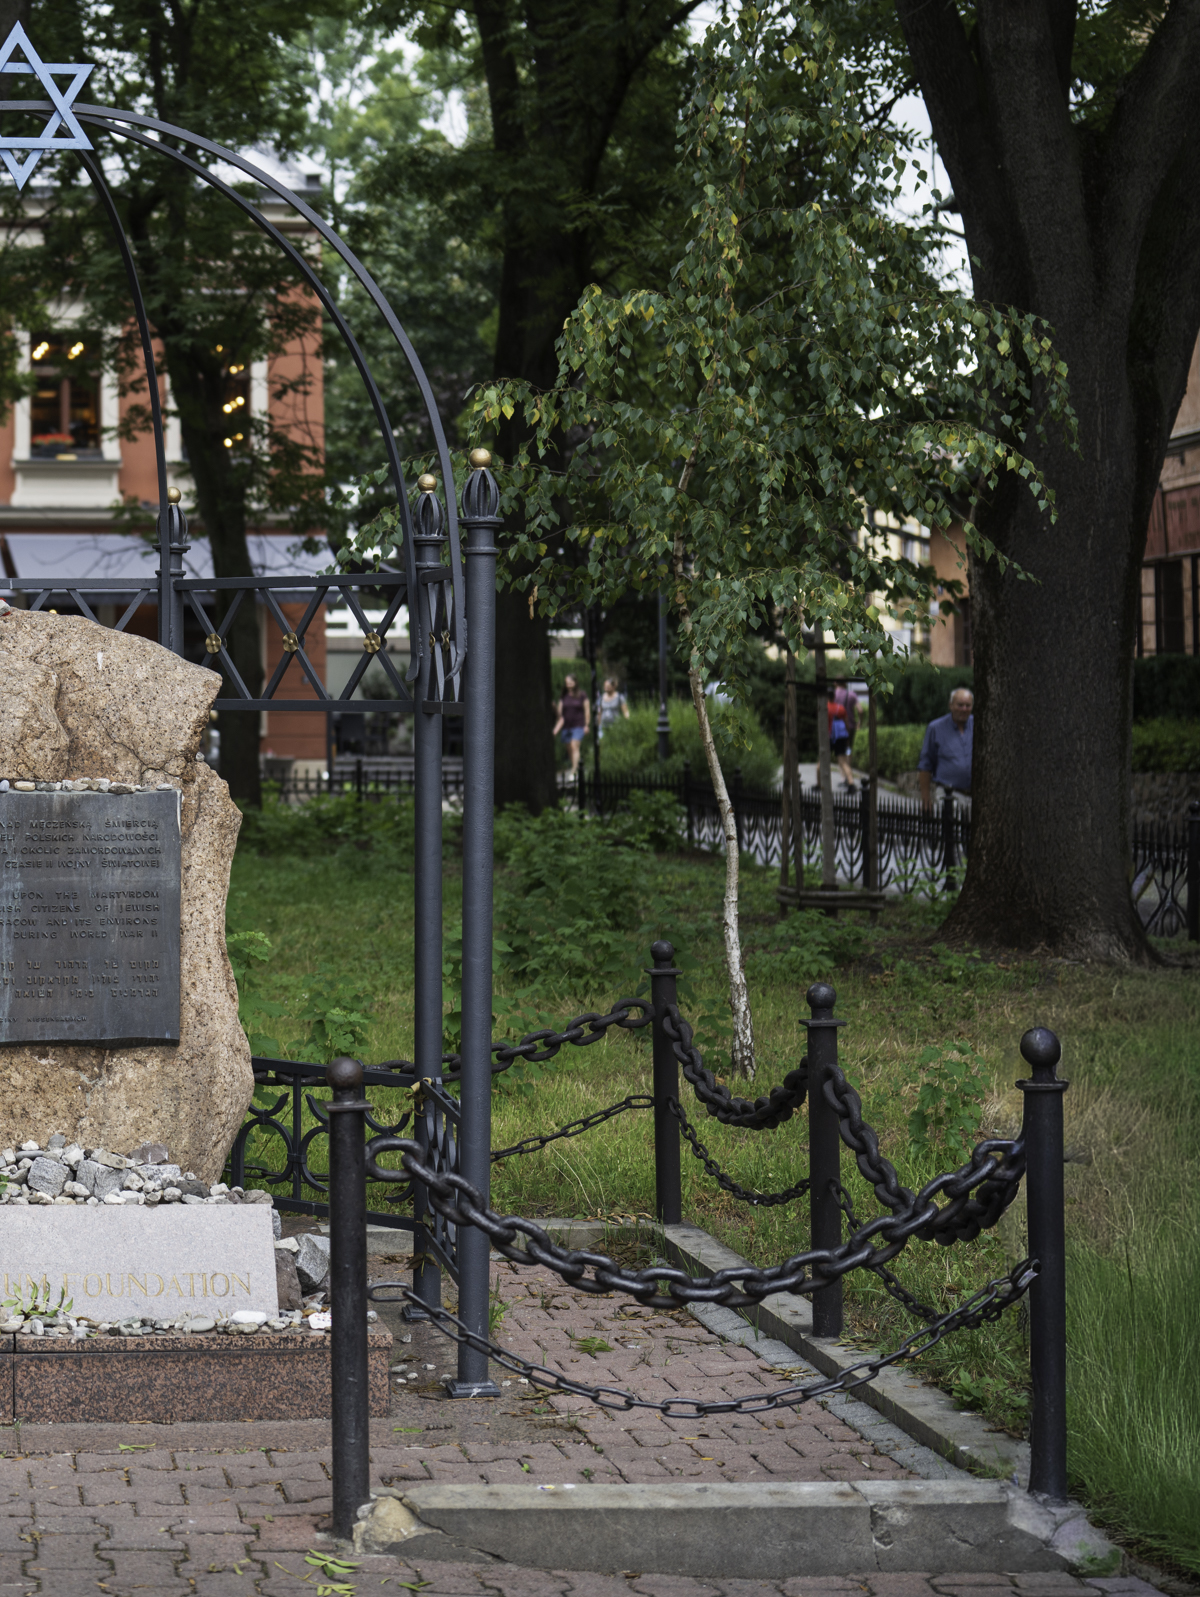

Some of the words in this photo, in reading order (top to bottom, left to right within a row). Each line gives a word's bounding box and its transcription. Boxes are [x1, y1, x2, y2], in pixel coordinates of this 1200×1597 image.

[25, 833, 74, 842] POLSKICH
[82, 831, 159, 842] NARODOWOŚCI
[20, 846, 60, 855] OKOLIC
[67, 846, 162, 855] ZAMORDOWANYCH
[4, 860, 42, 868] CZASIE
[58, 860, 92, 869] WOJNY
[12, 891, 43, 900] UPON
[55, 891, 78, 899] THE
[90, 890, 159, 899] MARTYRDOM
[31, 905, 81, 913] CITIZENS
[94, 904, 109, 912] OF
[119, 904, 160, 913] JEWISH
[46, 918, 68, 926] AND
[74, 918, 92, 926] ITS
[100, 917, 158, 926] ENVIRONS
[13, 931, 57, 939] DURING
[70, 930, 107, 939] WORLD
[119, 930, 144, 938] WAR
[27, 959, 41, 969] על
[130, 960, 160, 971] מקום
[62, 1272, 251, 1298] FOUNDATION
